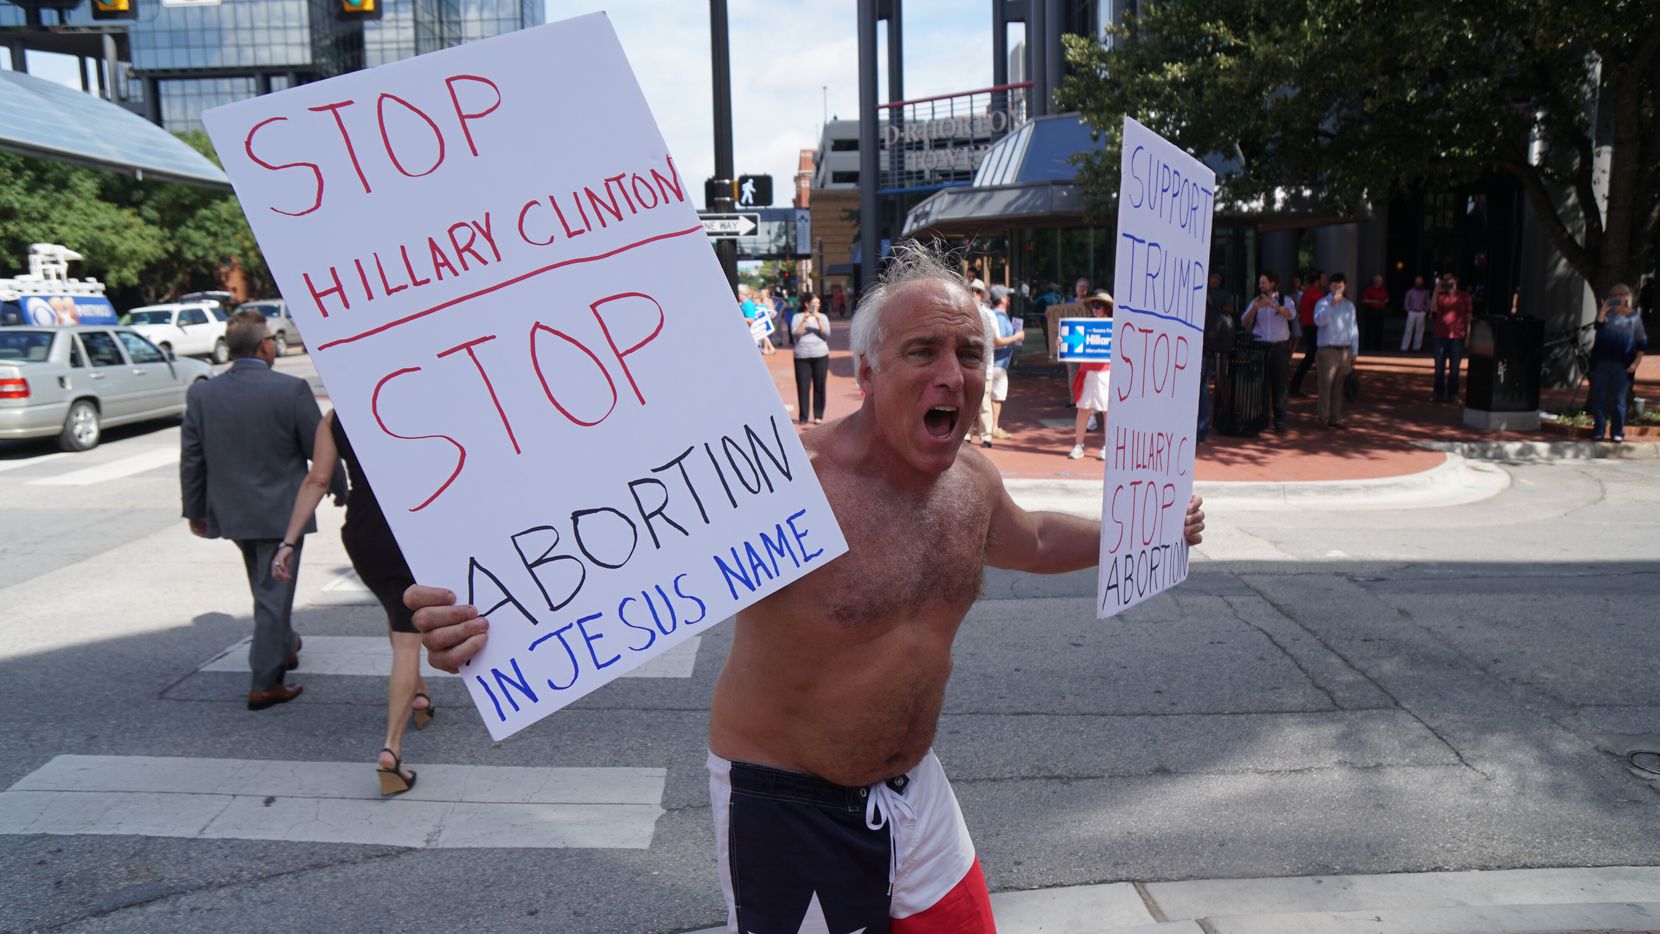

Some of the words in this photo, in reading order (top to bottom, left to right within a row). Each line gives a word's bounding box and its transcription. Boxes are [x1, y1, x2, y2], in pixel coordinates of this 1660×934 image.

[244, 74, 501, 216] STOP
[302, 211, 501, 318] HILLARY
[517, 153, 684, 245] CLINTON
[704, 221, 715, 231] NE
[720, 221, 738, 231] WAY
[1128, 145, 1213, 243] SUPPORT
[1122, 233, 1204, 326] TRUMP
[1085, 334, 1112, 345] Hillar
[1118, 322, 1188, 402] STOP
[372, 292, 664, 512] STOP
[1115, 426, 1174, 476] HILLARY
[466, 415, 792, 665] ABORTION
[1109, 480, 1176, 554] STOP
[477, 658, 539, 722] IN
[528, 573, 707, 691] JESUS
[713, 509, 824, 600] NAME
[1102, 537, 1187, 611] ABORTION
